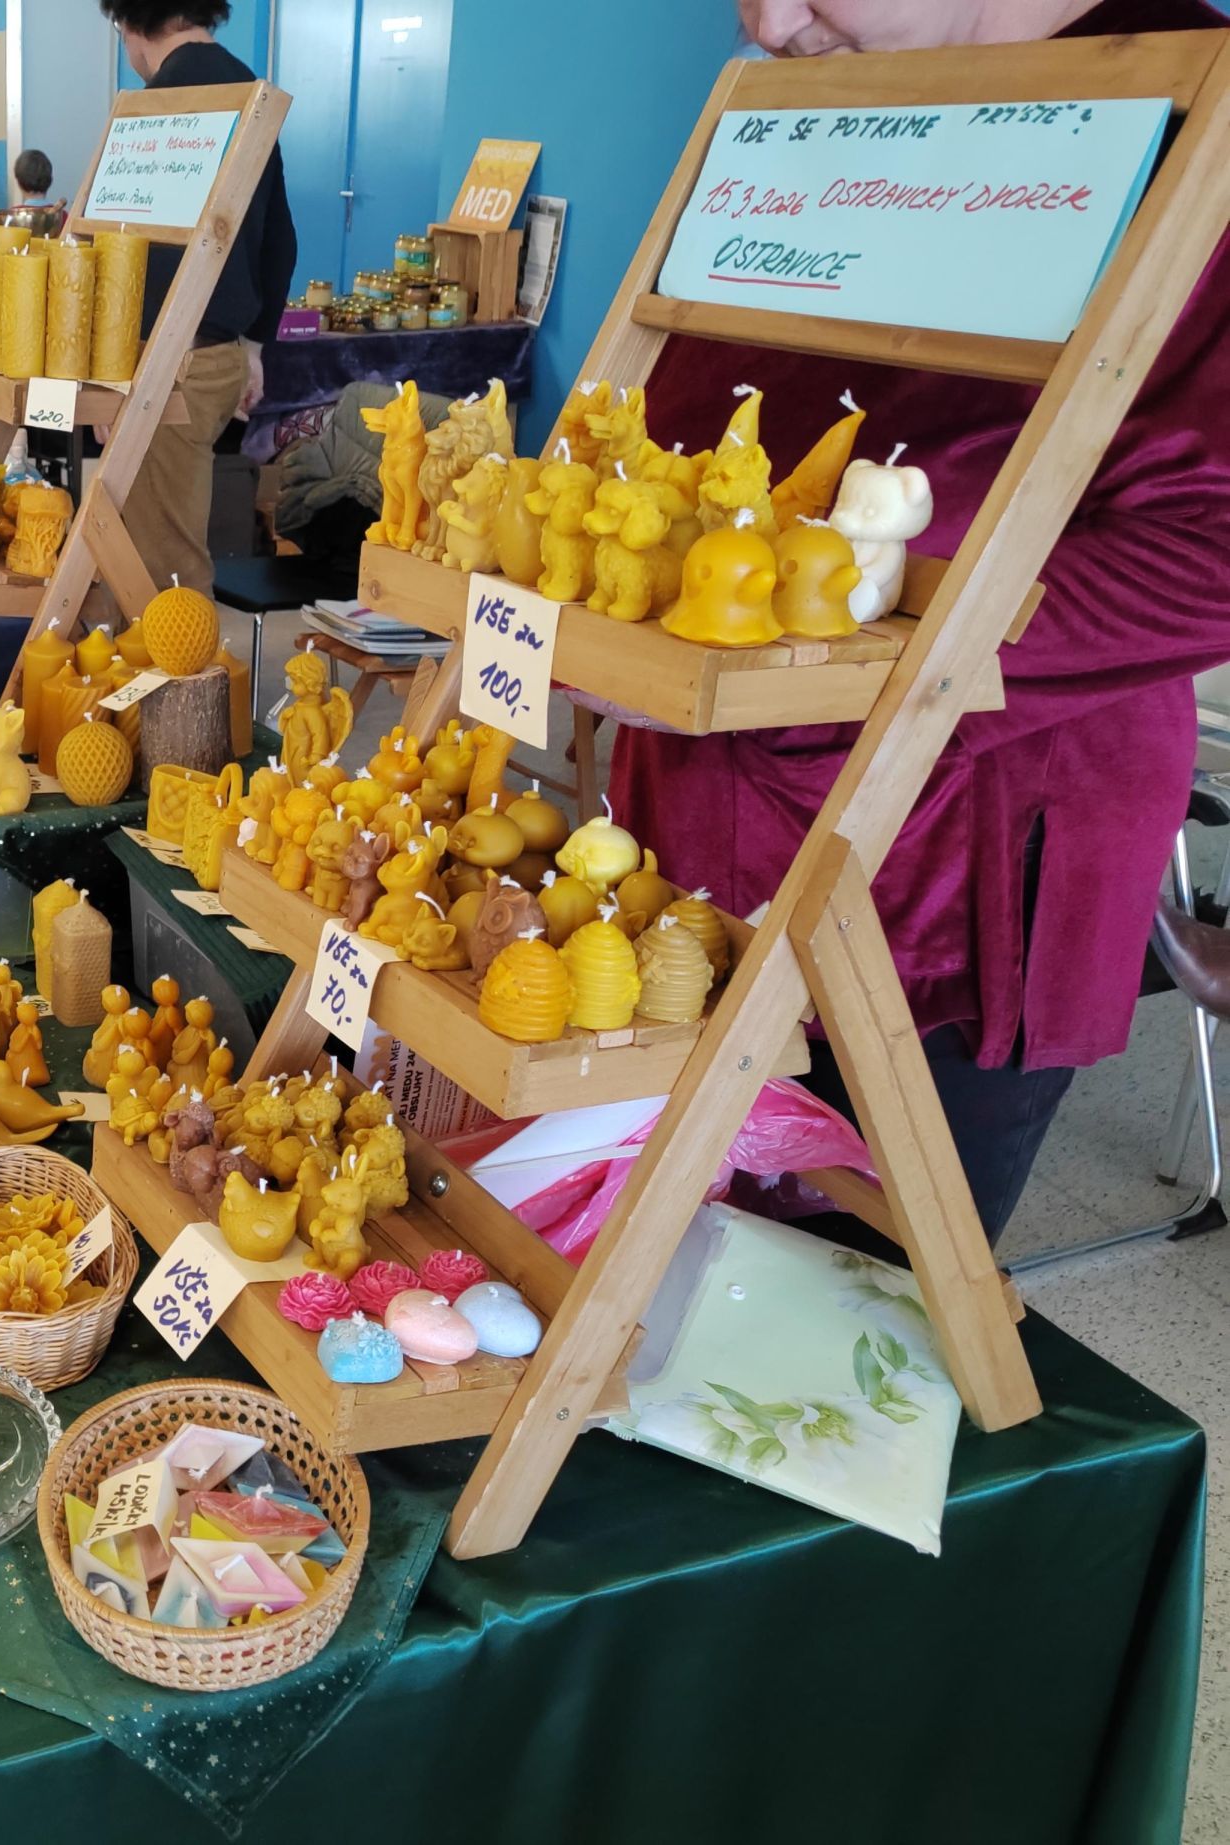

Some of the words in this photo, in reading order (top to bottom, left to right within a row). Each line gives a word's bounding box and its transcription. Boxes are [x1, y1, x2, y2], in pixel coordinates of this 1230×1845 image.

[733, 116, 779, 144] KDE
[788, 116, 821, 142] SE
[459, 185, 513, 223] MED
[713, 233, 862, 280] OSTRAVICE
[479, 661, 531, 718] 100,-
[321, 973, 352, 1027] 70,-
[387, 1063, 398, 1082] NA
[401, 1070, 414, 1103] MEDU
[408, 1070, 423, 1121] OBSLUHY
